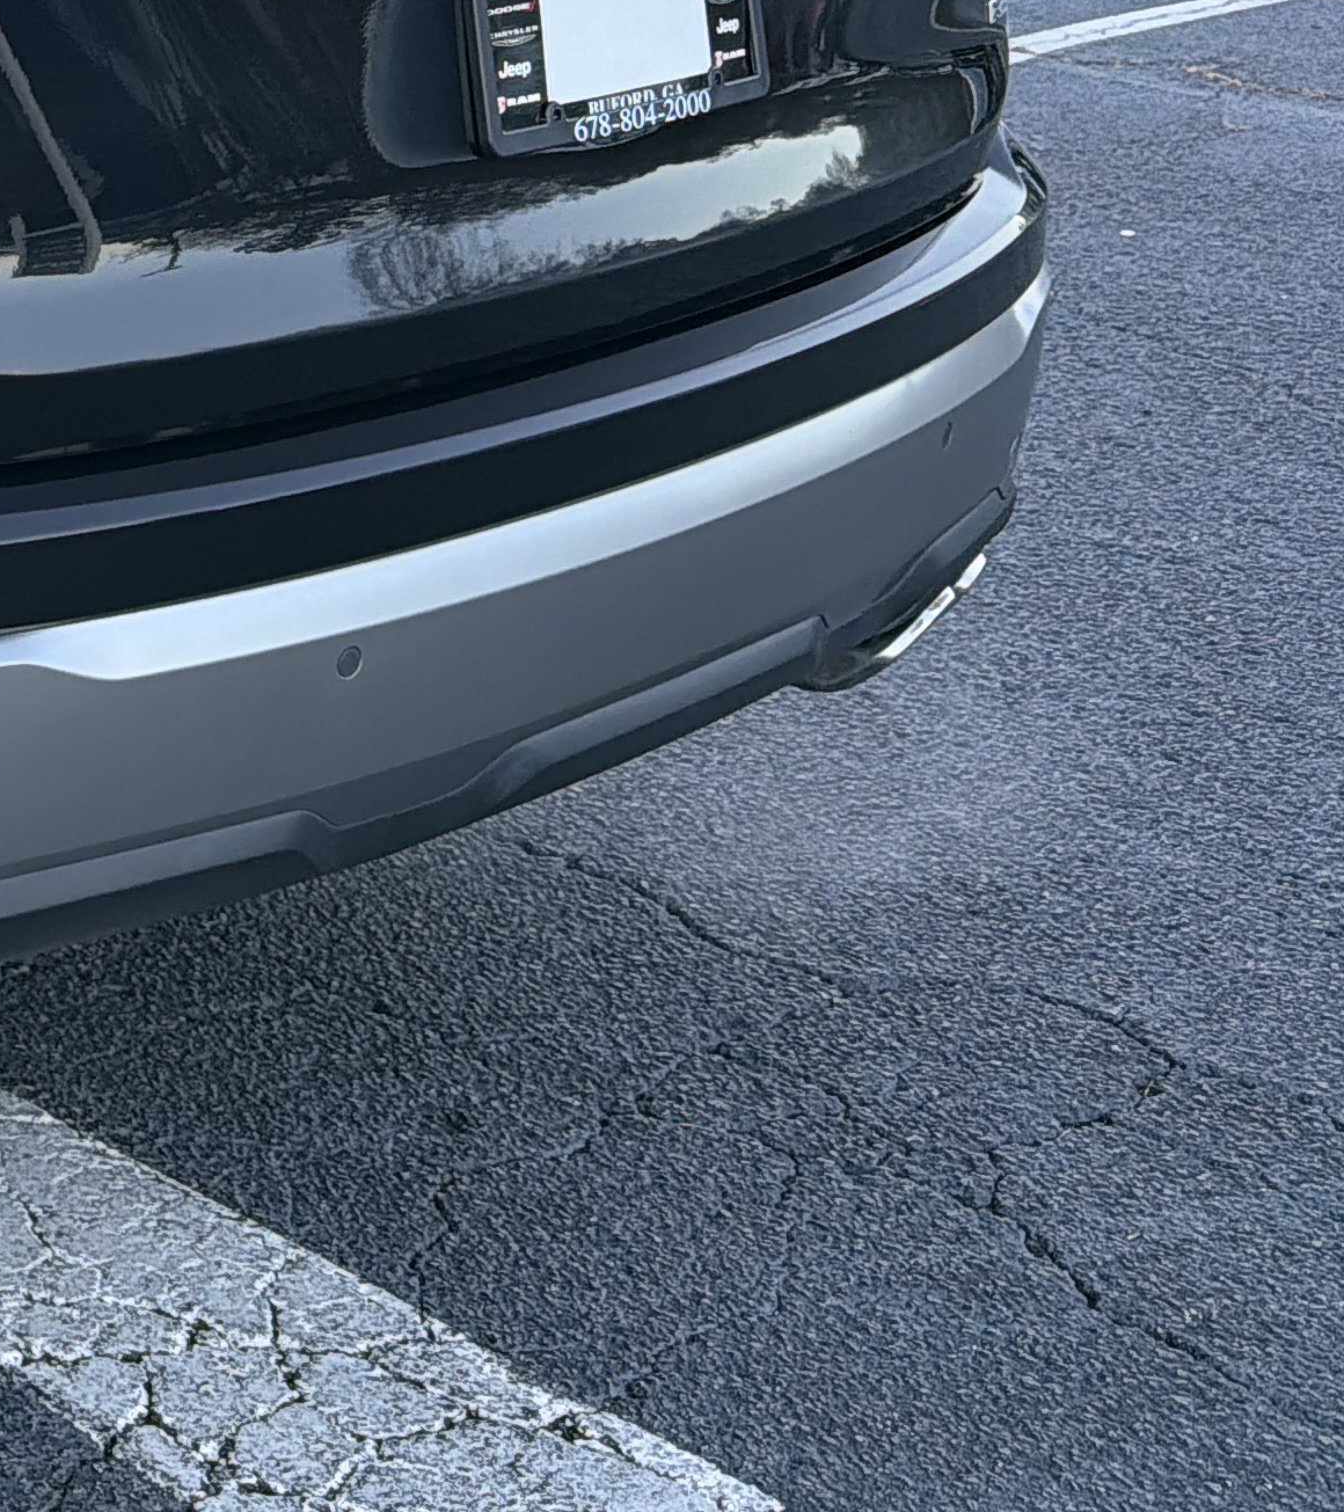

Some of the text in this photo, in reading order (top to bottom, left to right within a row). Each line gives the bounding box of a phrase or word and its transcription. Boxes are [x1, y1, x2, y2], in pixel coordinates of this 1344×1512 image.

[716, 17, 740, 34] Jeep
[498, 60, 532, 79] Jeep
[506, 92, 541, 107] RAM
[574, 88, 711, 142] 678-804-2000
